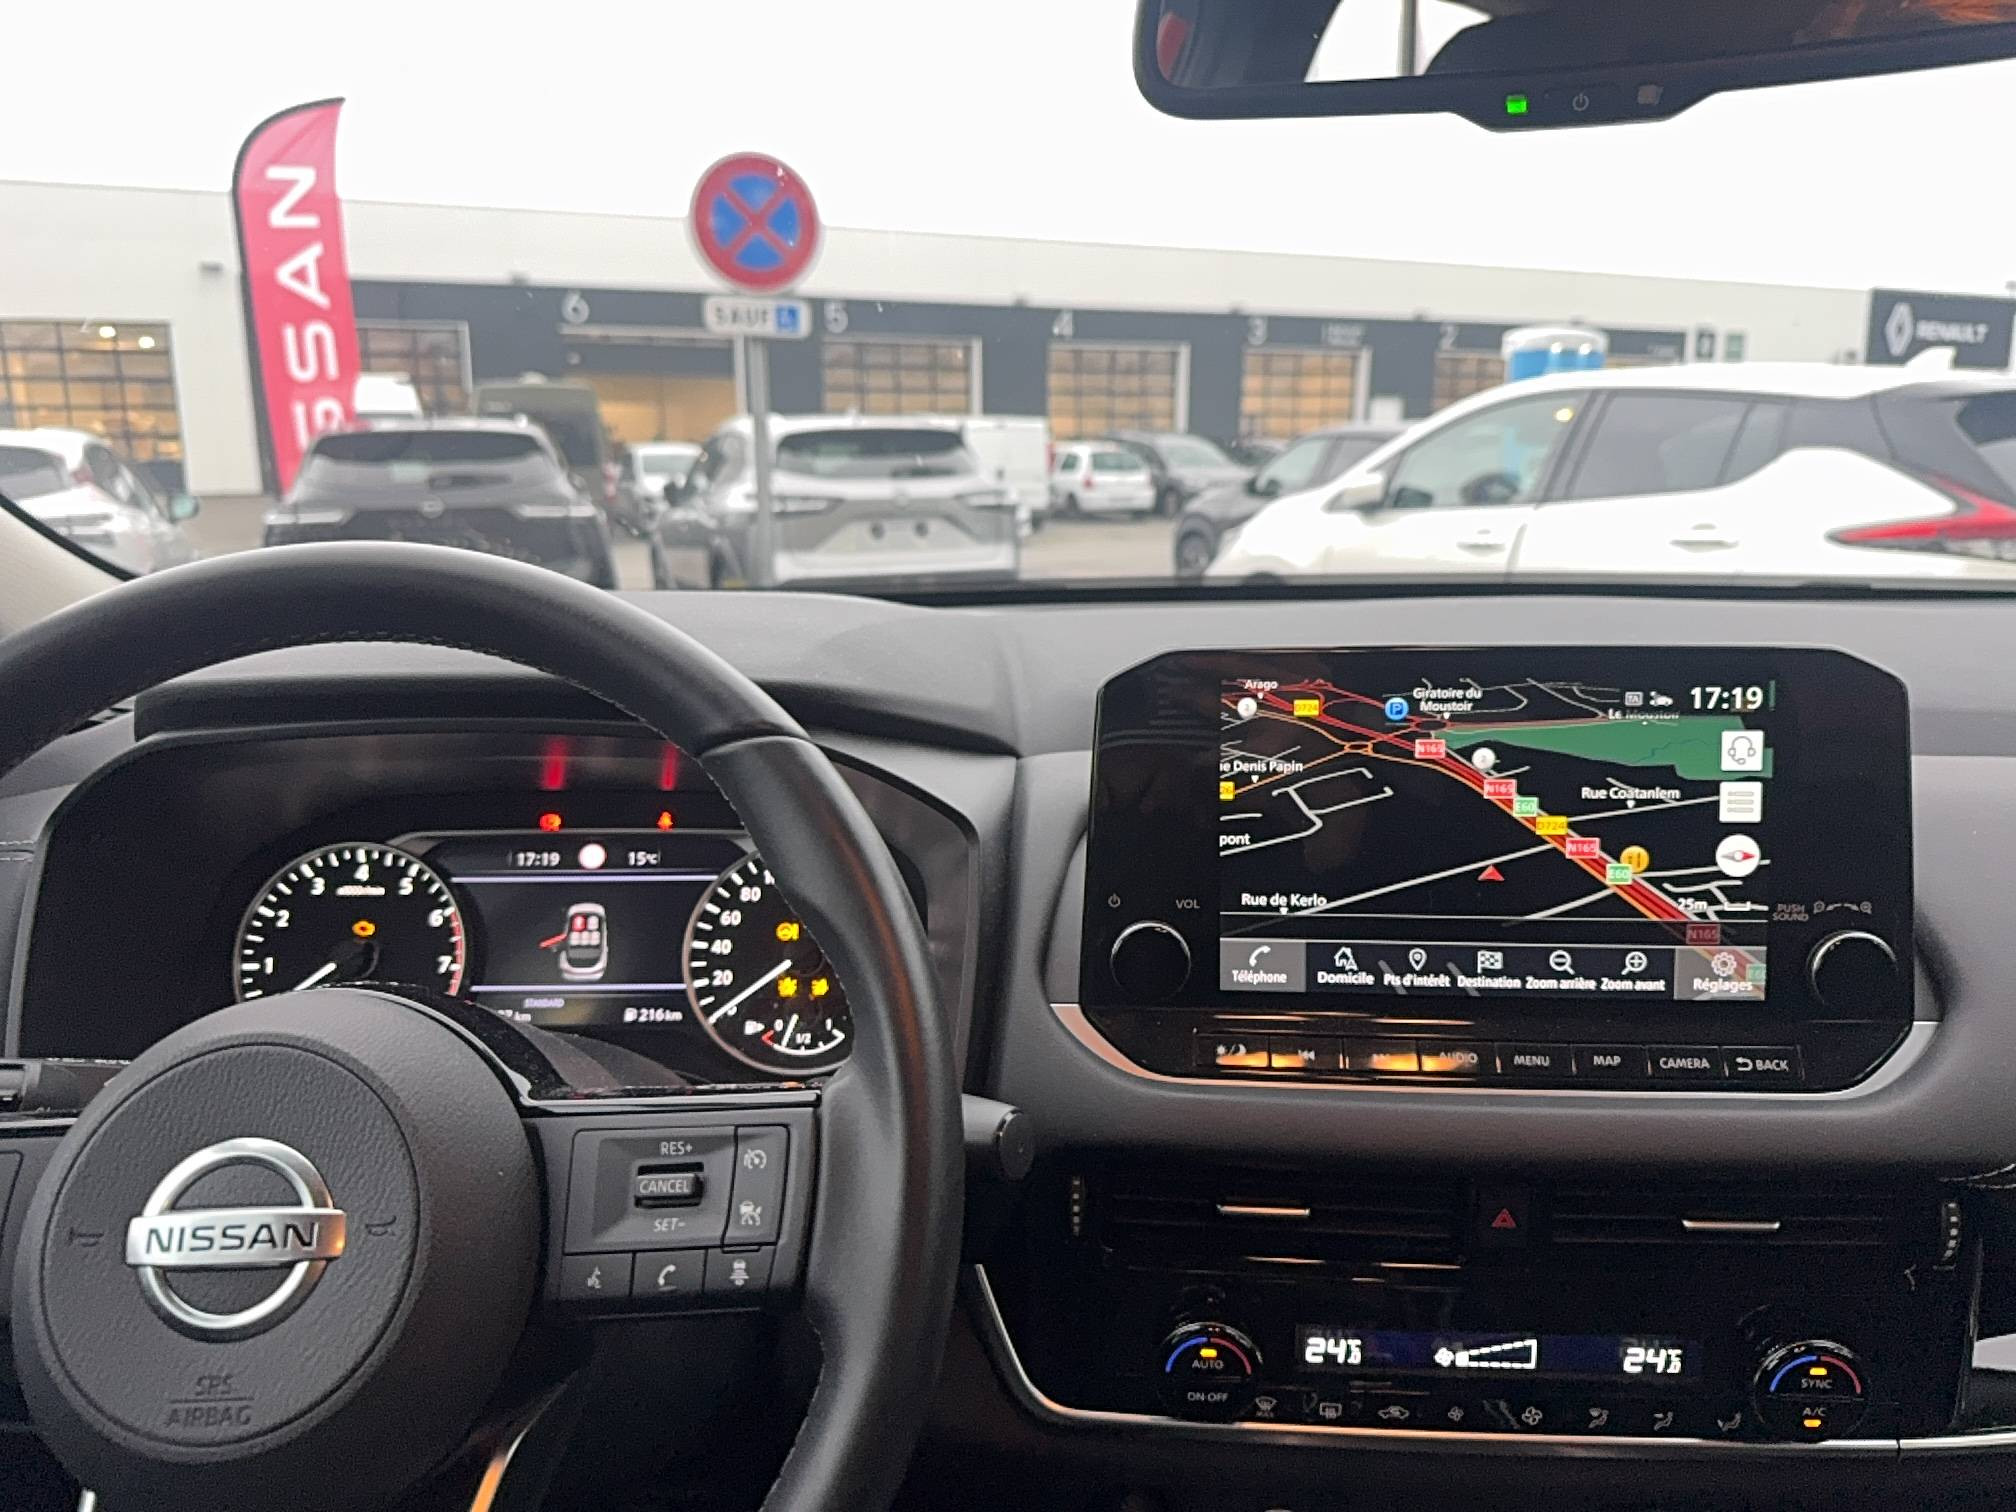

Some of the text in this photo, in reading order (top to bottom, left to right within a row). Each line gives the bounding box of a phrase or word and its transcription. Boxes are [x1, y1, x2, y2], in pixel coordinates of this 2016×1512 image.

[1244, 679, 1278, 690] Arago
[1413, 687, 1483, 699] Giratoire du
[1690, 685, 1764, 710] 17:19
[1420, 701, 1473, 711] Moustoir
[1233, 760, 1267, 773] Denis
[1269, 760, 1303, 775] Papin
[1581, 787, 1607, 800] Rue
[1219, 831, 1250, 847] pont
[516, 851, 561, 866] 17:19
[353, 863, 370, 882] 4
[310, 876, 326, 896] 3
[398, 876, 414, 896] 5
[739, 886, 762, 903] 80
[1241, 893, 1327, 907] Rue de Kerlo
[1175, 899, 1200, 909] VOL
[1678, 897, 1708, 911] 25m
[1777, 904, 1805, 912] PUSH
[275, 910, 290, 928] 2
[427, 908, 444, 928] 6
[719, 909, 742, 926] 60
[1772, 912, 1809, 922] SOUND
[710, 938, 733, 955] 40
[264, 956, 274, 974] 1
[437, 954, 453, 974] 7
[712, 969, 734, 986] 20
[1232, 969, 1287, 985] Téléphone
[1317, 970, 1375, 985] Domicile
[1457, 974, 1521, 988] Destination
[1525, 976, 1559, 989] Zoom
[1600, 976, 1666, 991] Zoom avant
[1693, 977, 1753, 993] Réglages
[1513, 1055, 1550, 1067] MENU
[1593, 1055, 1621, 1067] MAP
[1659, 1057, 1711, 1069] CAMERA
[1756, 1059, 1789, 1071] BACK
[660, 1141, 693, 1155] RES+
[640, 1179, 690, 1194] CANCEL
[146, 1222, 319, 1254] NISSAN
[1192, 1359, 1225, 1370] AUTO
[1801, 1378, 1833, 1389] SYNC
[1802, 1407, 1827, 1417] A/C
